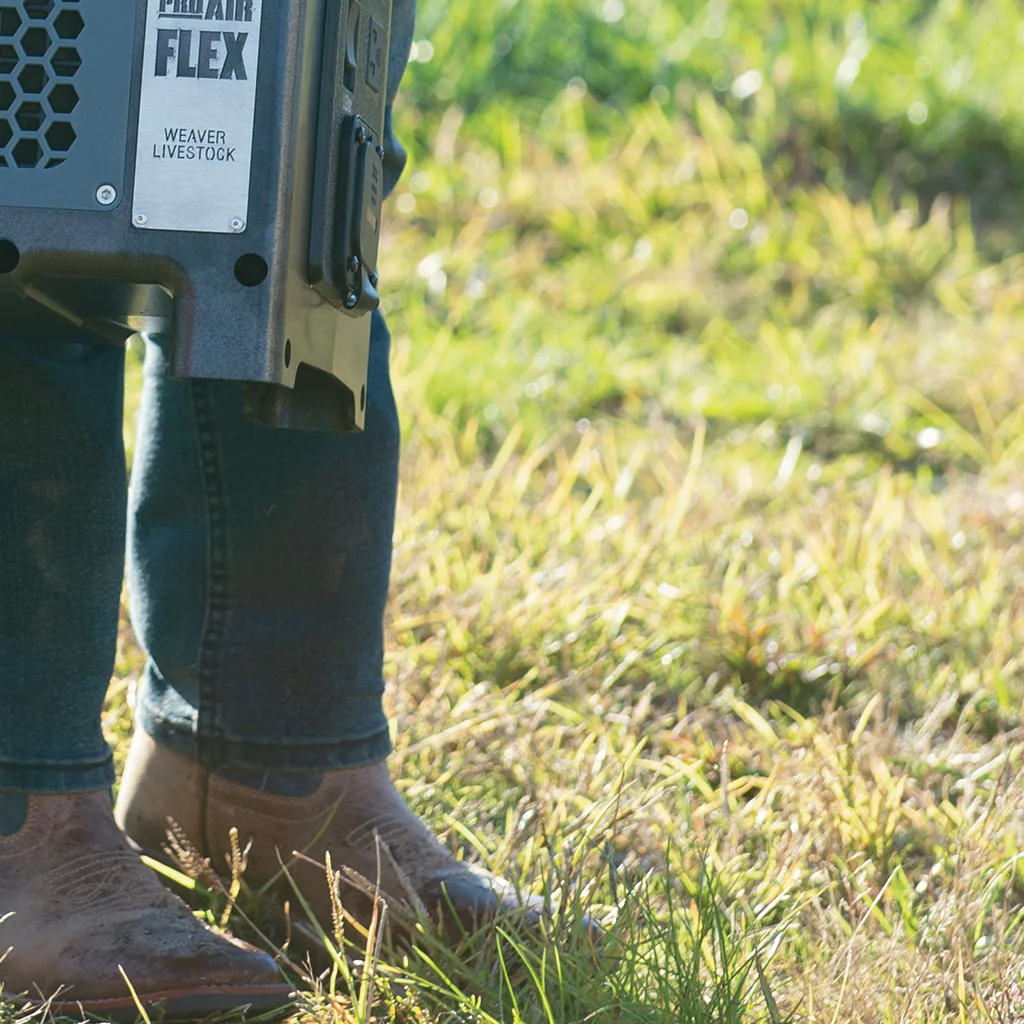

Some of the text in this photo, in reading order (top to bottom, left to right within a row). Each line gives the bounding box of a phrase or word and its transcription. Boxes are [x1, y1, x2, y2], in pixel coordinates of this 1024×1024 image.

[154, 29, 249, 80] FLEX
[164, 128, 226, 144] WEAVER
[153, 144, 236, 161] LIVESTOCK
